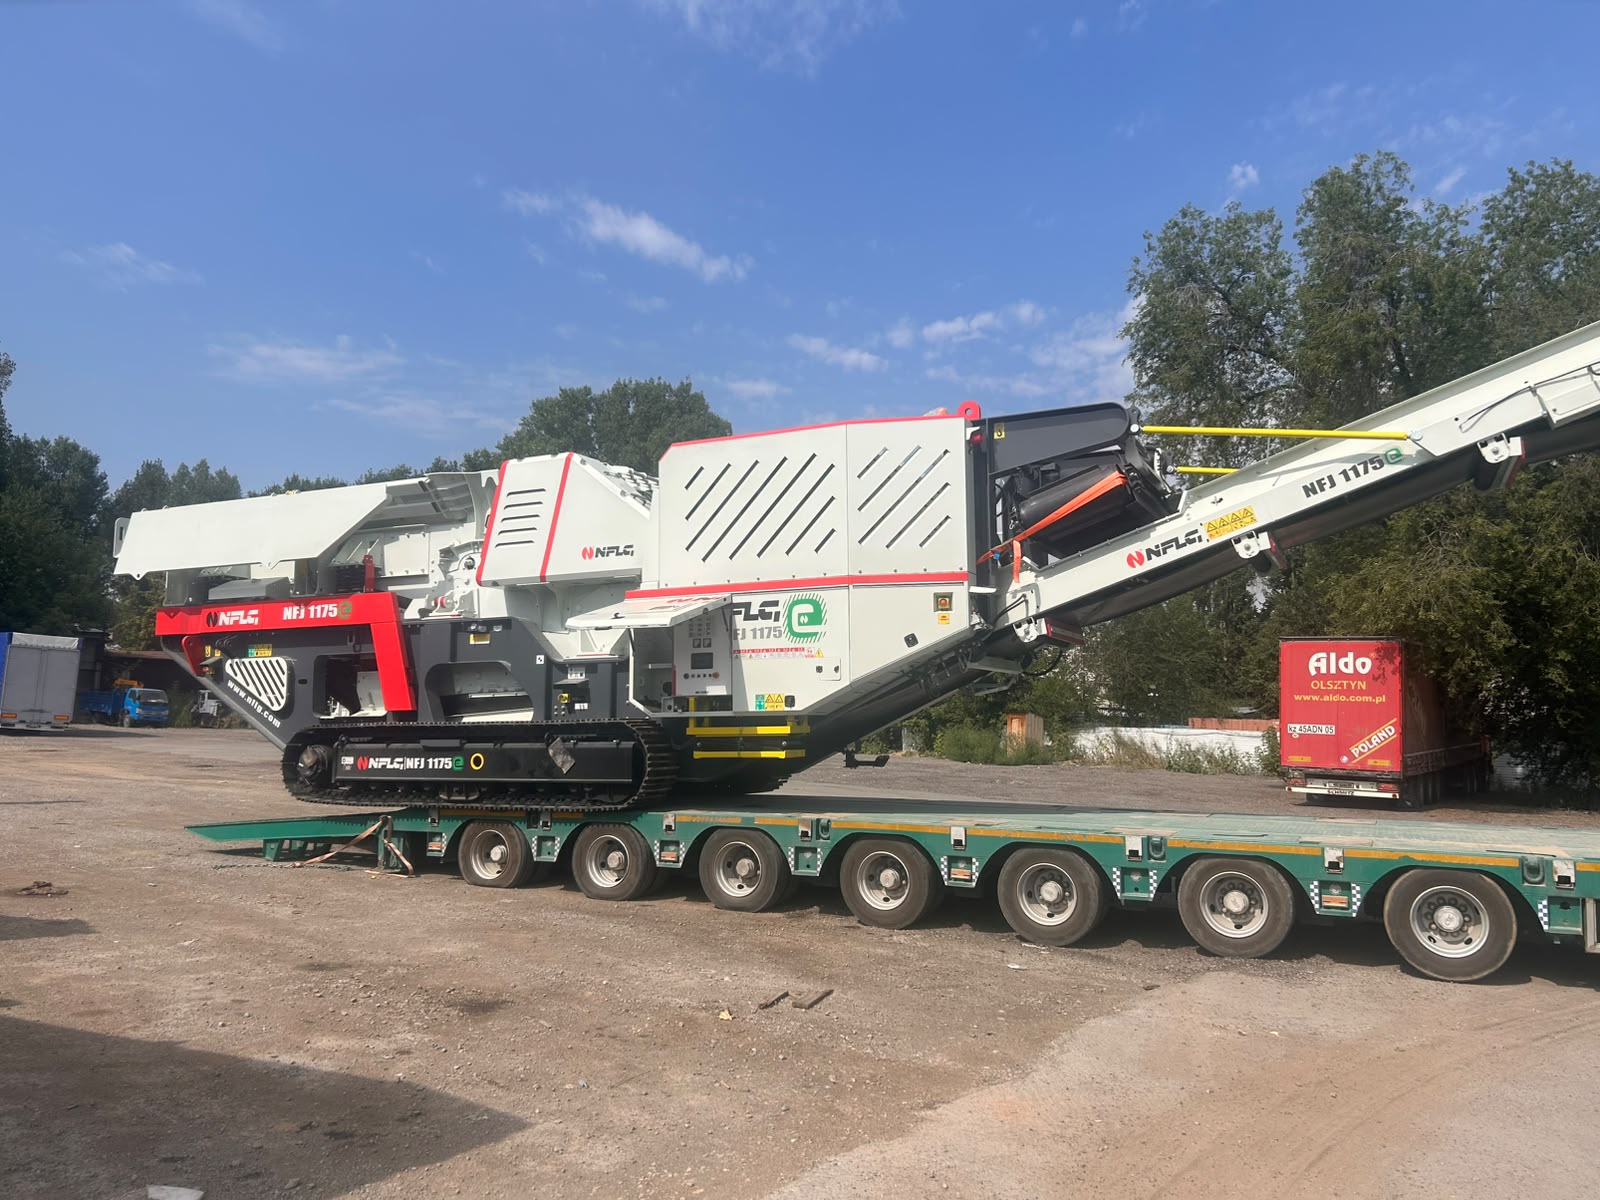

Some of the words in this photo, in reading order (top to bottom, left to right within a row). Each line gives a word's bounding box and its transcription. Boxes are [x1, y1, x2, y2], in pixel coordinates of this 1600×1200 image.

[1302, 474, 1336, 498] NFJ
[595, 544, 634, 558] NFLG
[1145, 529, 1203, 561] NFLG
[218, 609, 259, 626] NFLG
[283, 605, 305, 620] NFJ
[732, 600, 781, 622] FLG
[733, 628, 746, 640] FJ
[750, 626, 783, 639] 1175
[1308, 652, 1372, 676] Aldo
[1311, 680, 1367, 690] OLSZTYN
[1293, 694, 1386, 704] www.aldo.com.pl
[1298, 725, 1323, 733] 45ADN
[1325, 726, 1334, 734] 05
[1351, 725, 1396, 758] POLAND
[368, 757, 404, 770] NFLG
[406, 757, 425, 769] NFJ
